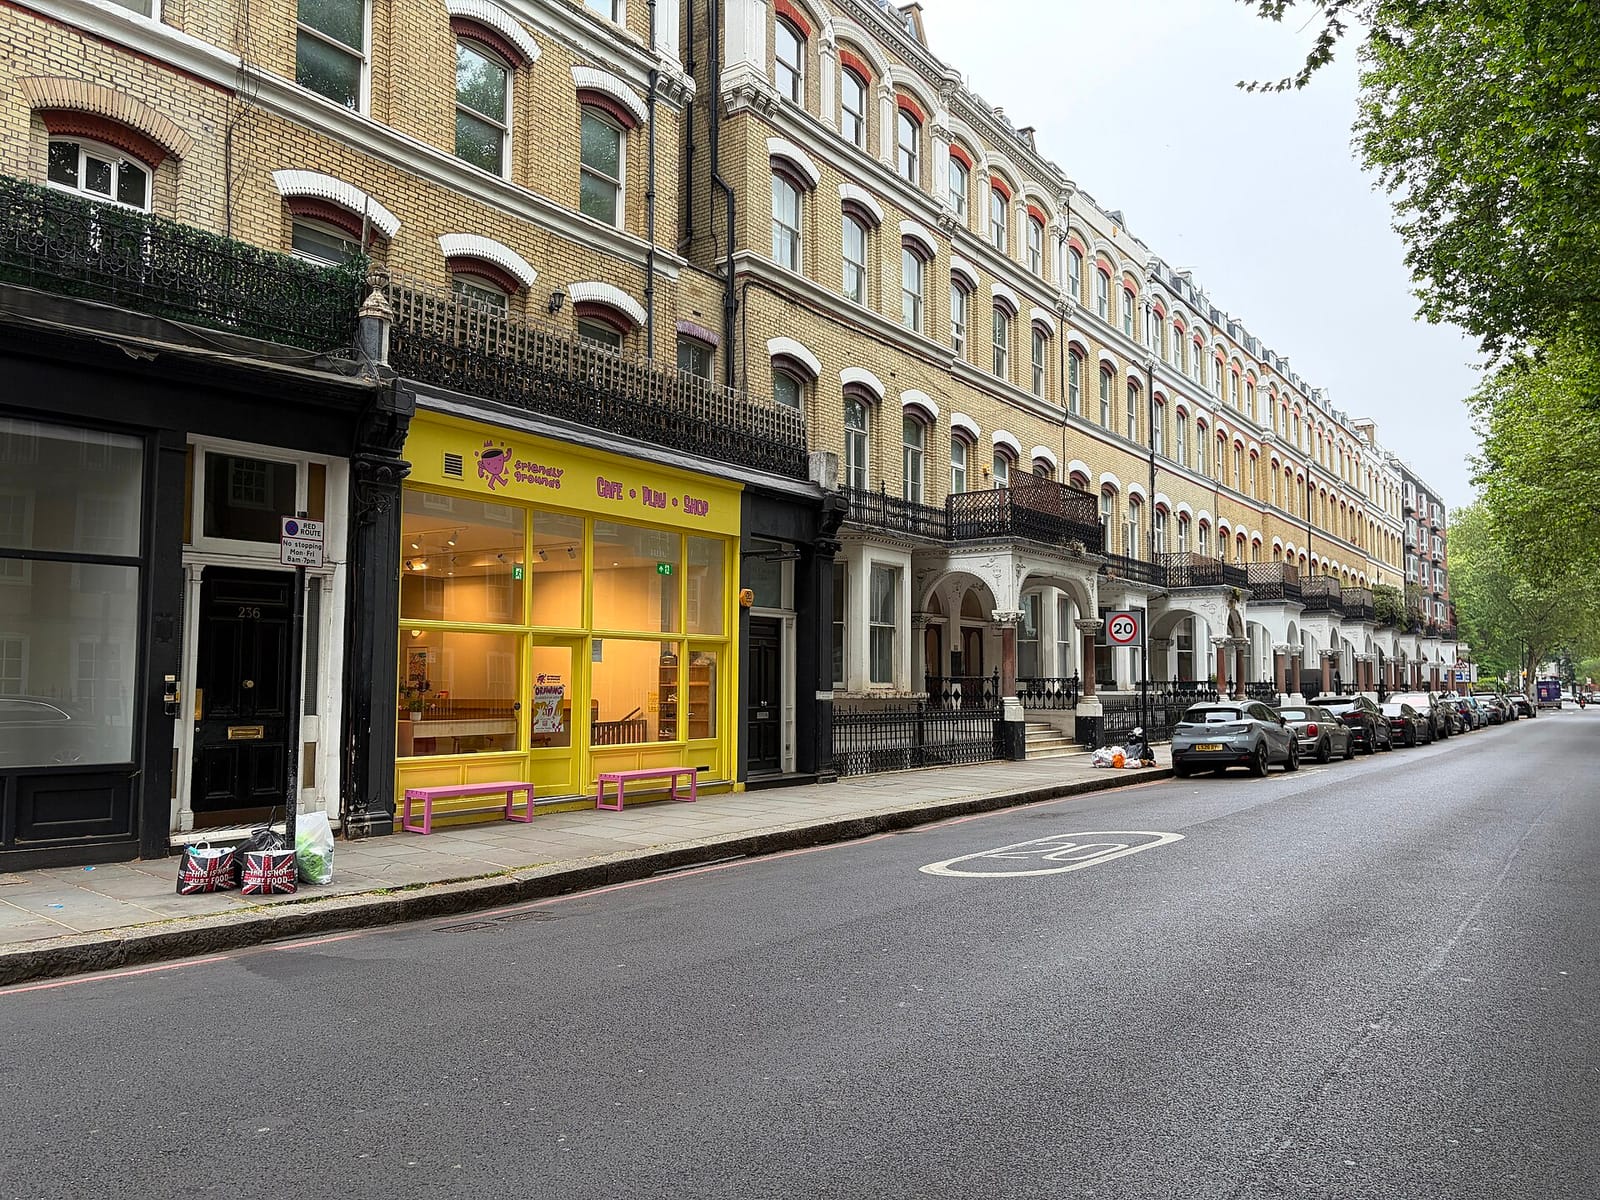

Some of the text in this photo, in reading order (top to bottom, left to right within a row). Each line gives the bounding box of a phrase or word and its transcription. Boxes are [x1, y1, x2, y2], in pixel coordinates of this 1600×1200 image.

[514, 459, 564, 478] friendly
[514, 471, 561, 490] grounds
[596, 476, 709, 517] CAFE PLAY SHOP
[283, 539, 322, 551] No stopping
[237, 606, 261, 619] 236
[1113, 622, 1133, 634] 20
[982, 841, 1130, 862] 20
[209, 869, 216, 877] IS
[217, 867, 230, 875] NOT
[249, 868, 287, 877] THIS IS NOT
[211, 873, 229, 884] FOOD
[248, 876, 288, 885] JUST FOOD
